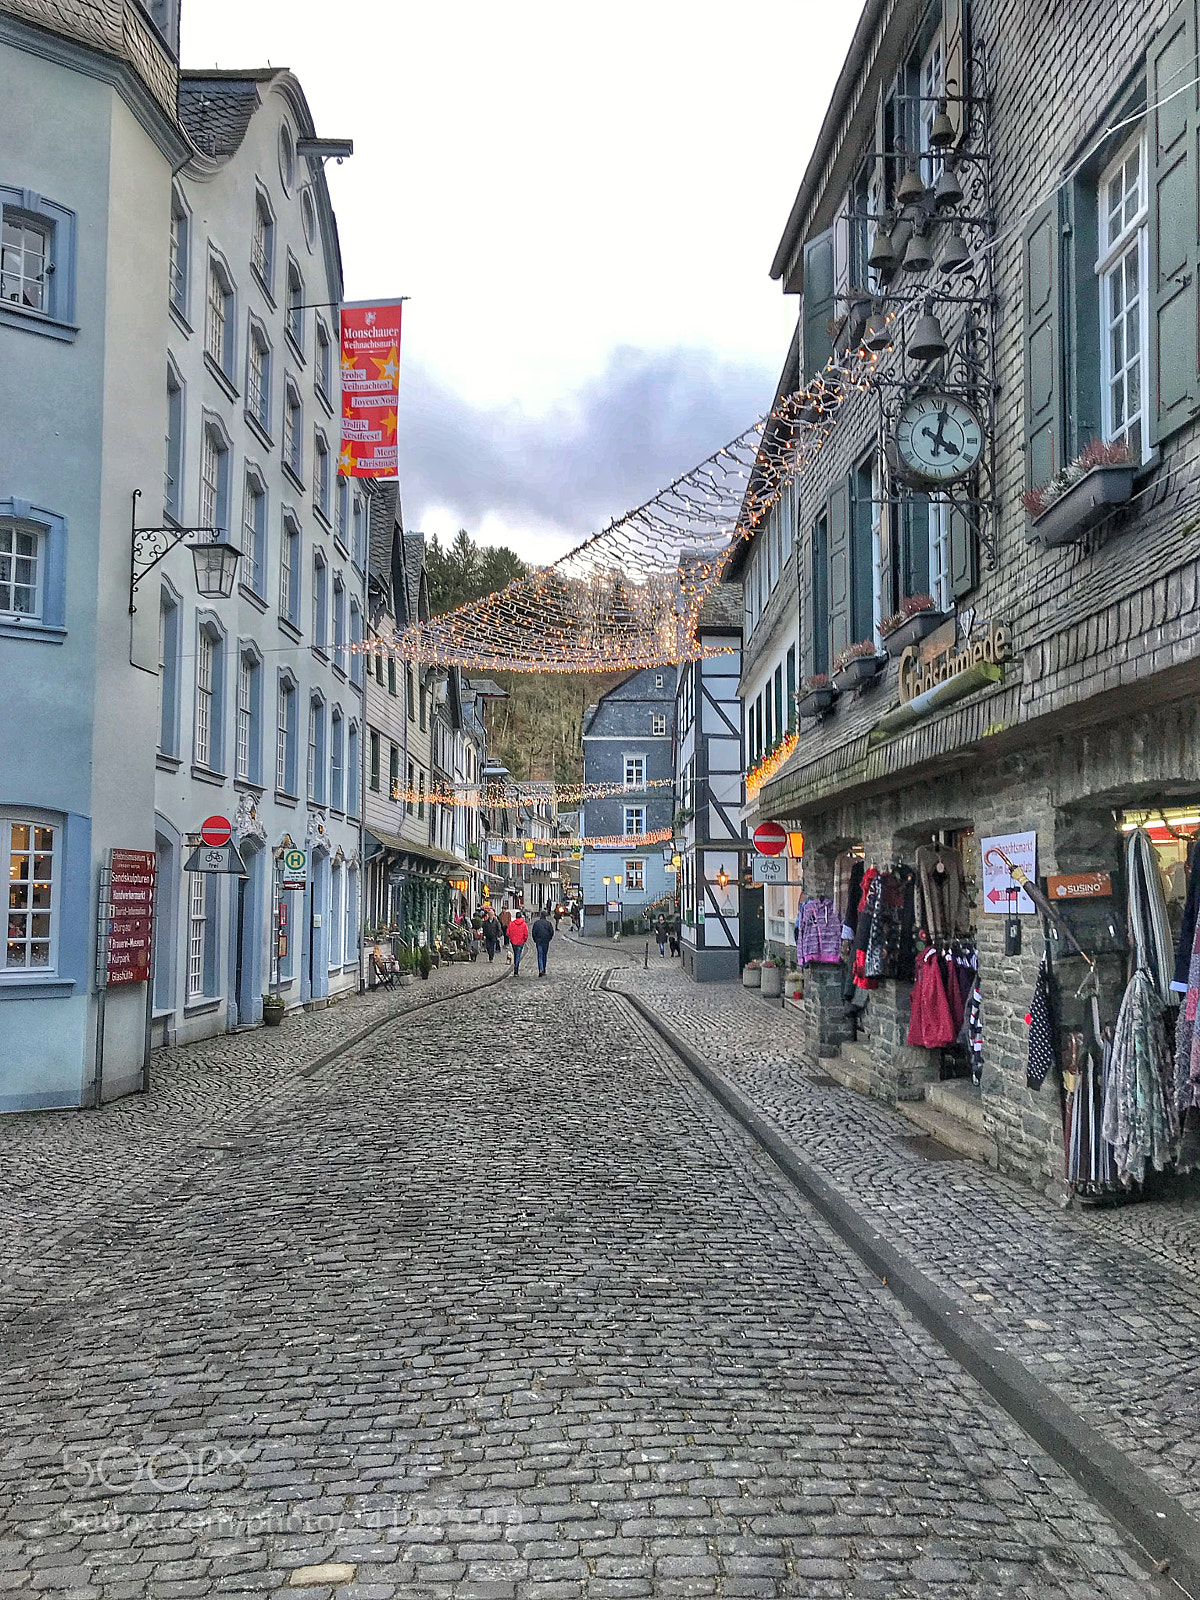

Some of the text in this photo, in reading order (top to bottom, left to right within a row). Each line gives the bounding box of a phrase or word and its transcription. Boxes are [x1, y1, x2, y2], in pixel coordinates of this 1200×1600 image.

[344, 326, 398, 339] Monschauer
[344, 339, 398, 349] Weihnachtsmarkt
[342, 371, 364, 379] Frohe
[353, 398, 379, 407] Joyeux
[899, 619, 1012, 705] Goldschmiede
[290, 854, 301, 866] H
[111, 872, 149, 885] Sandskulpturen
[1067, 883, 1101, 894] SUSINO
[113, 922, 131, 935] Burgau
[112, 952, 130, 966] Kurpark
[111, 968, 134, 981] Glashütte
